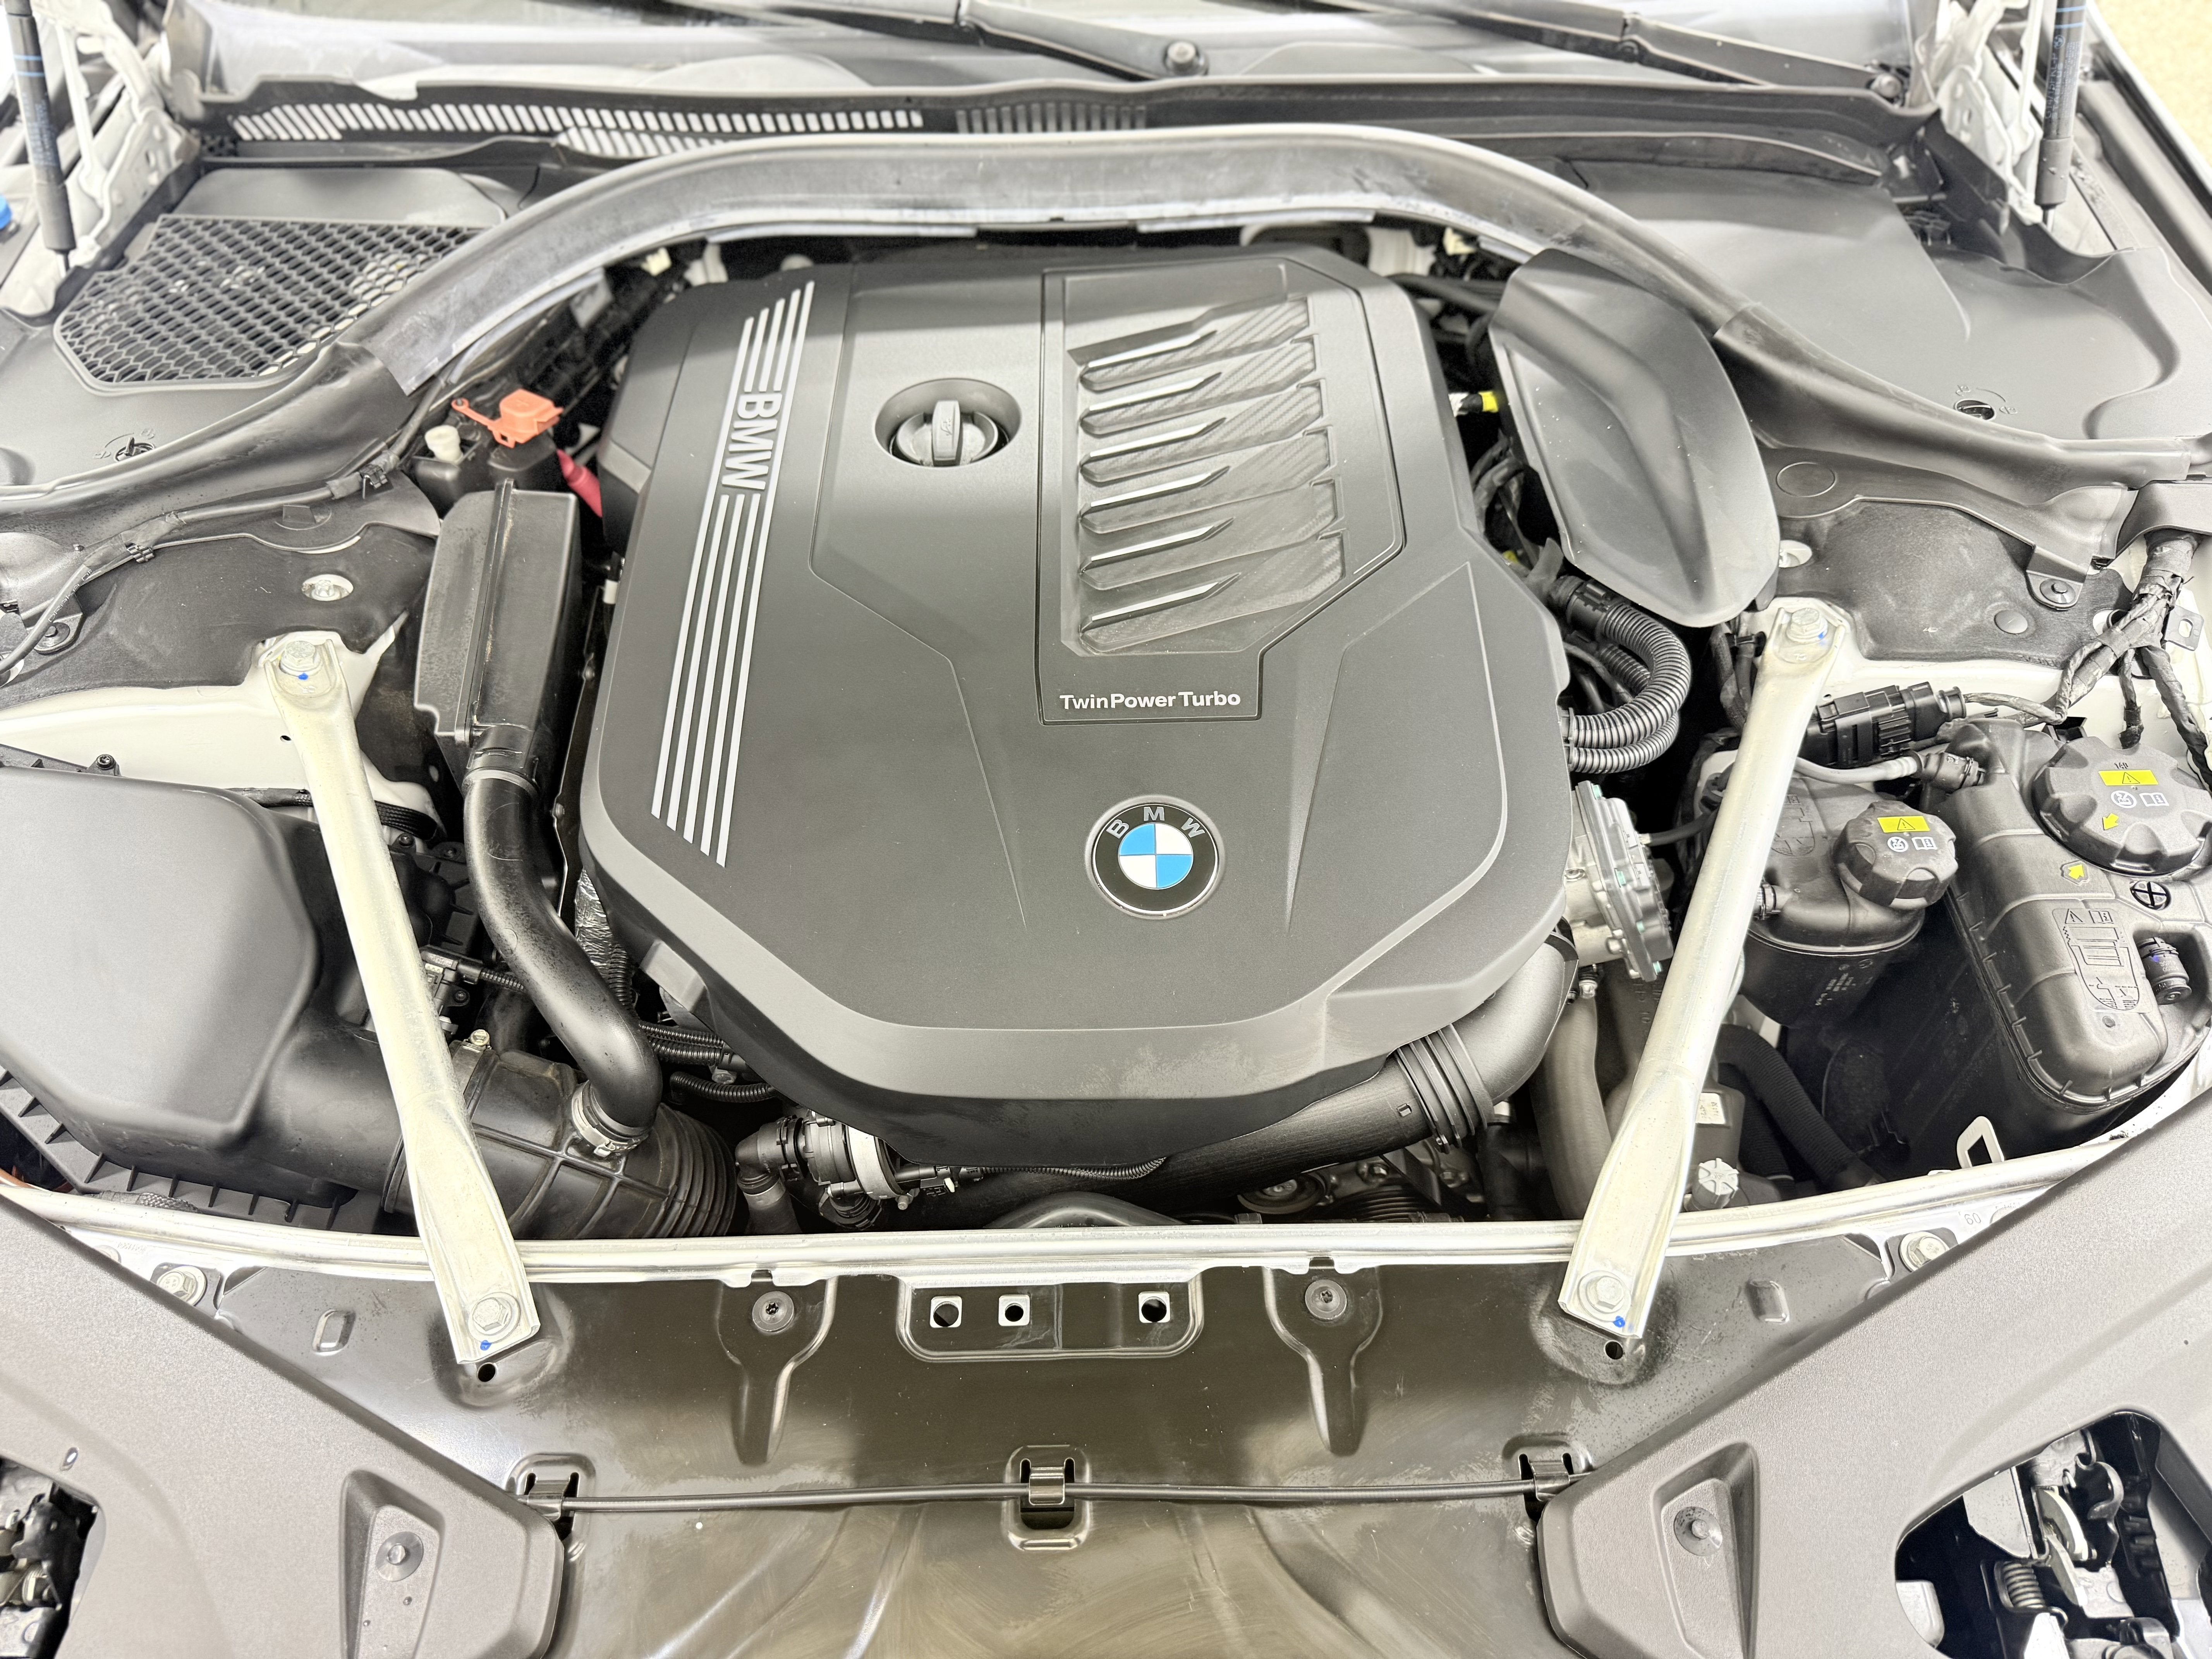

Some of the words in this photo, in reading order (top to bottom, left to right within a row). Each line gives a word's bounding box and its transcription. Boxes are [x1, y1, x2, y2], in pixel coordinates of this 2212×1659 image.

[721, 393, 783, 490] BMW
[1060, 693, 1176, 710] TwinPower
[1178, 691, 1241, 707] Turbo
[1106, 806, 1206, 840] BMW
